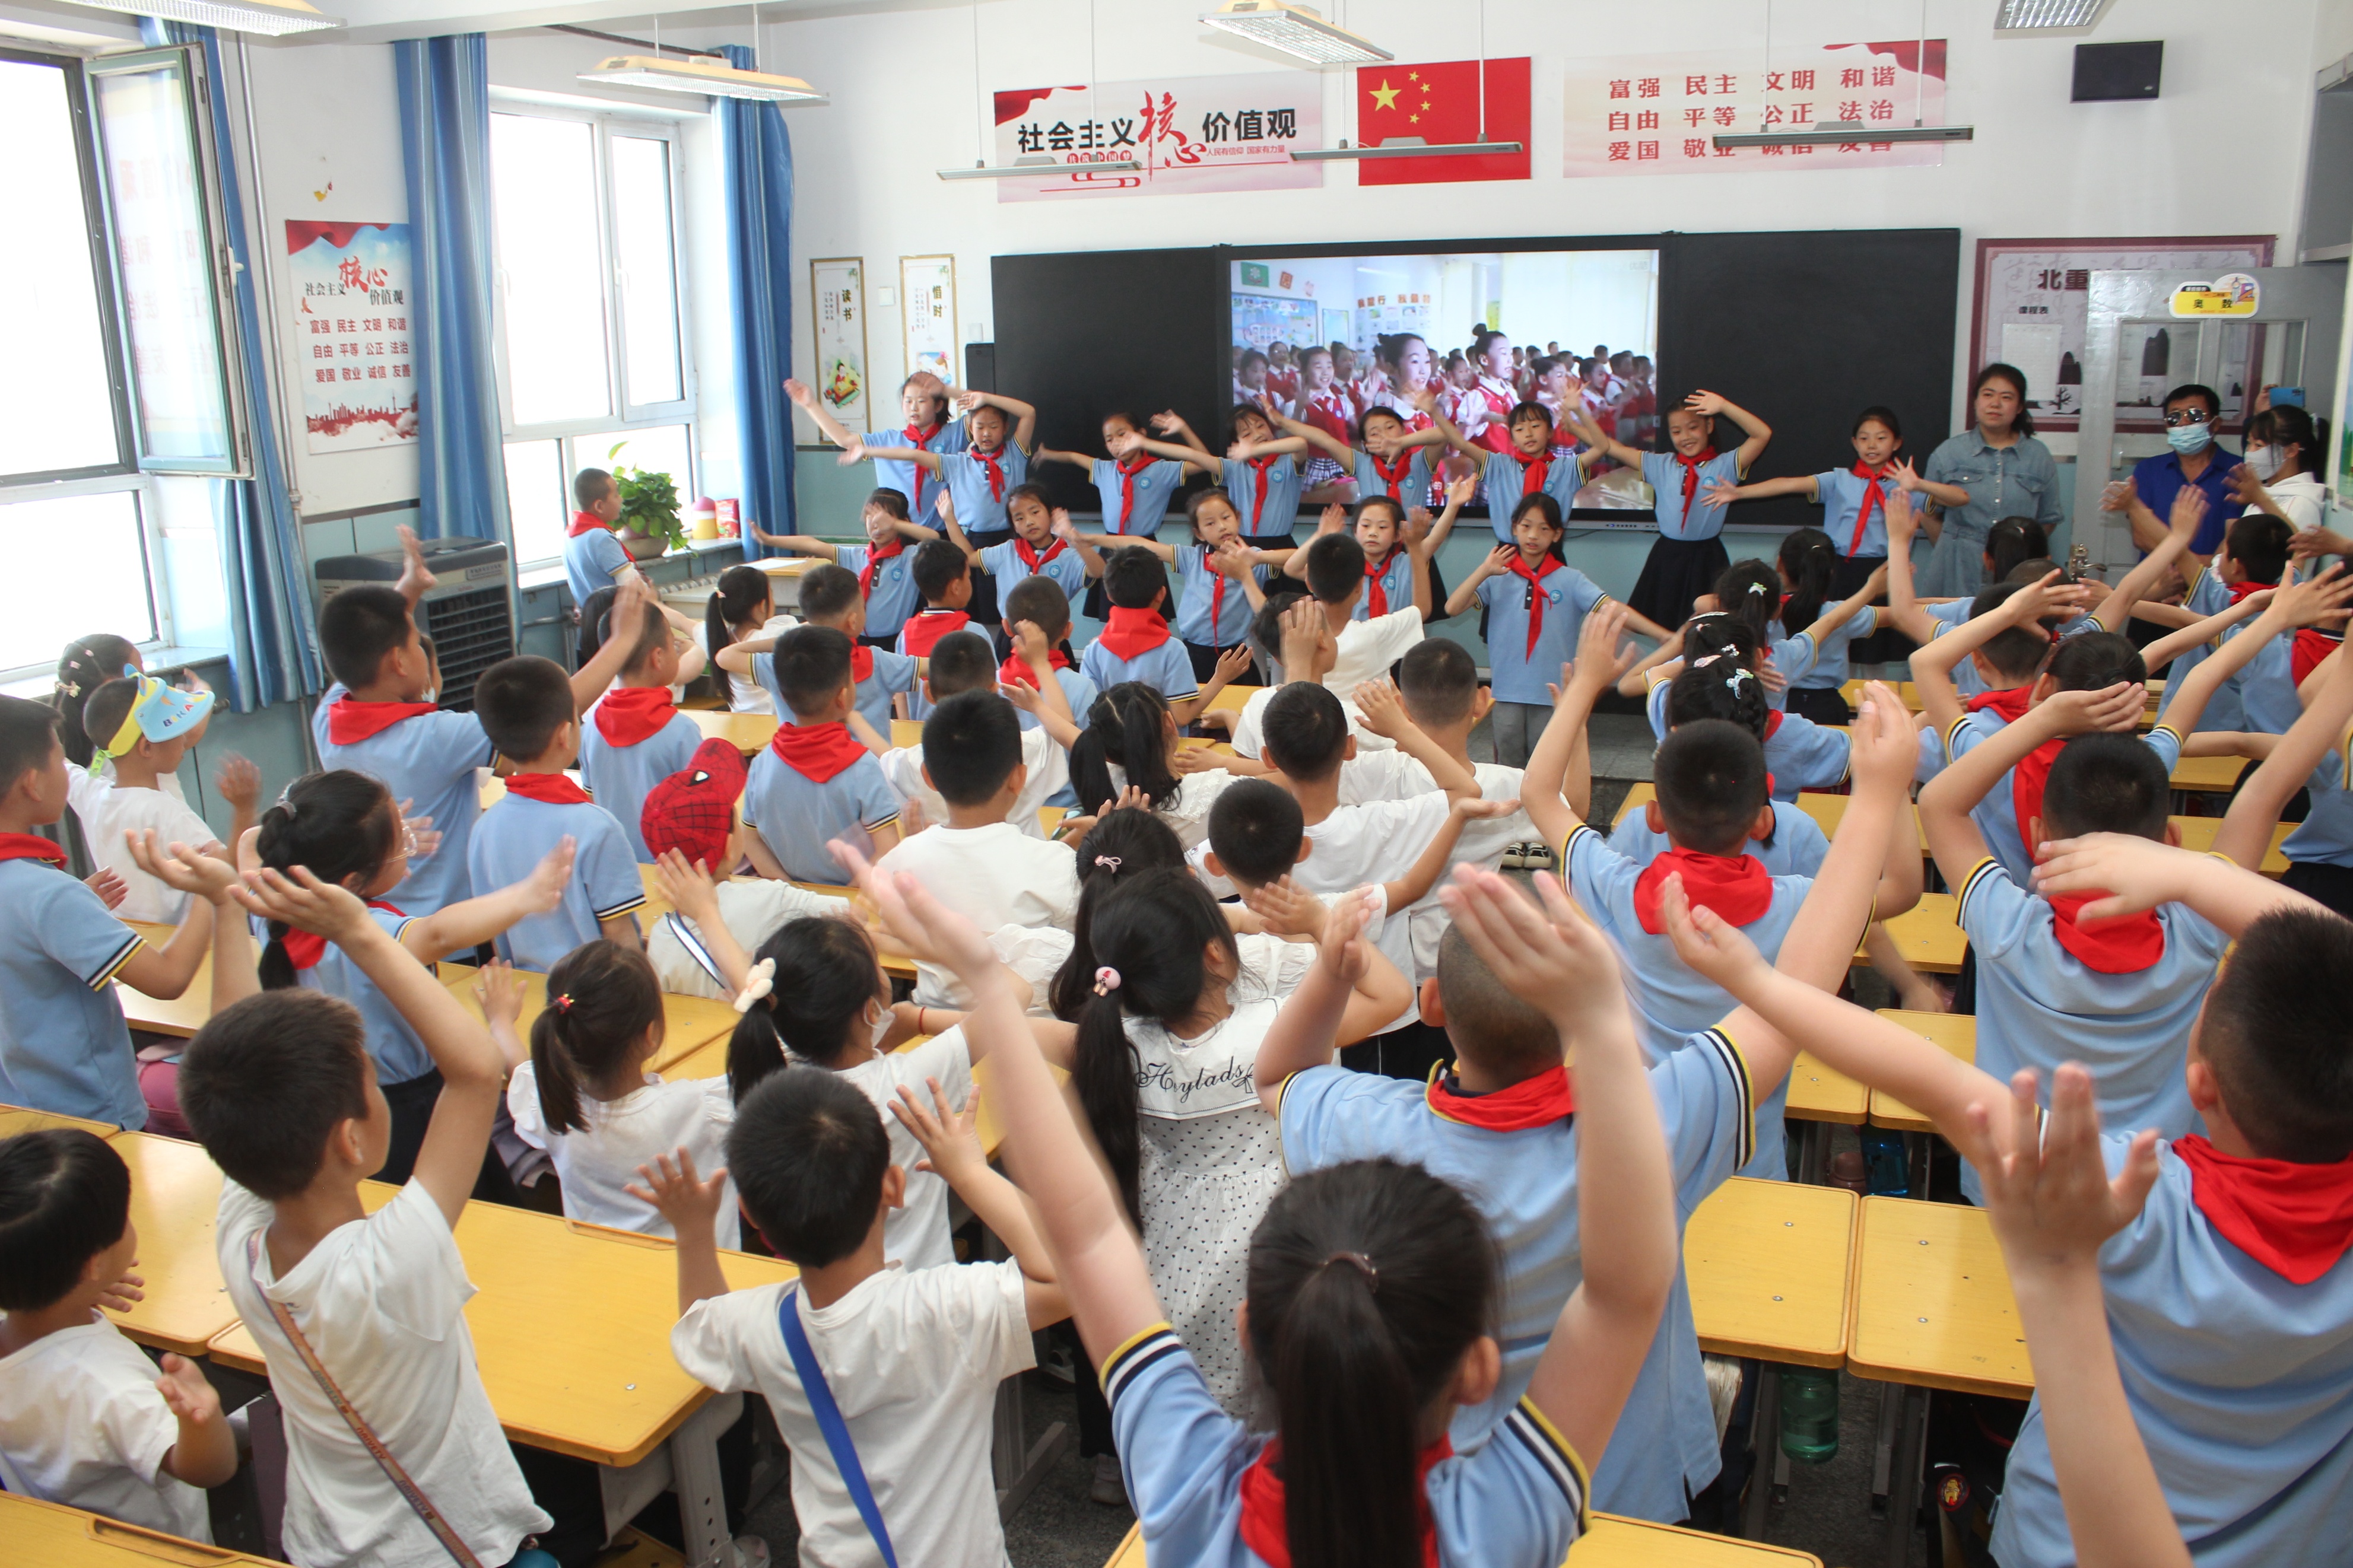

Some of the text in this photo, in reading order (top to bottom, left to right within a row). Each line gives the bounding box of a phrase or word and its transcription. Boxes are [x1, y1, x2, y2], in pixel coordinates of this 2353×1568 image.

[1609, 66, 1896, 100] 富强 民主 文明 和谐
[1609, 99, 1894, 131] 自由 平等 公正 法治
[1018, 90, 1297, 182] 社会主义 核心 价值观
[1247, 145, 1285, 155] 国家有力量
[1608, 140, 1660, 161] 爱国
[338, 256, 388, 293] 核心
[305, 282, 346, 297] 社会主义
[370, 288, 404, 306] 价值观
[842, 289, 852, 322] 读书
[932, 285, 942, 318] 惜时
[2019, 306, 2049, 314] 课程表
[310, 317, 407, 334] 富强 民主 文明 和谐
[313, 341, 409, 359] 自由 平等 公正 法治
[315, 364, 411, 383] 爱国 敬业 诚信 友善
